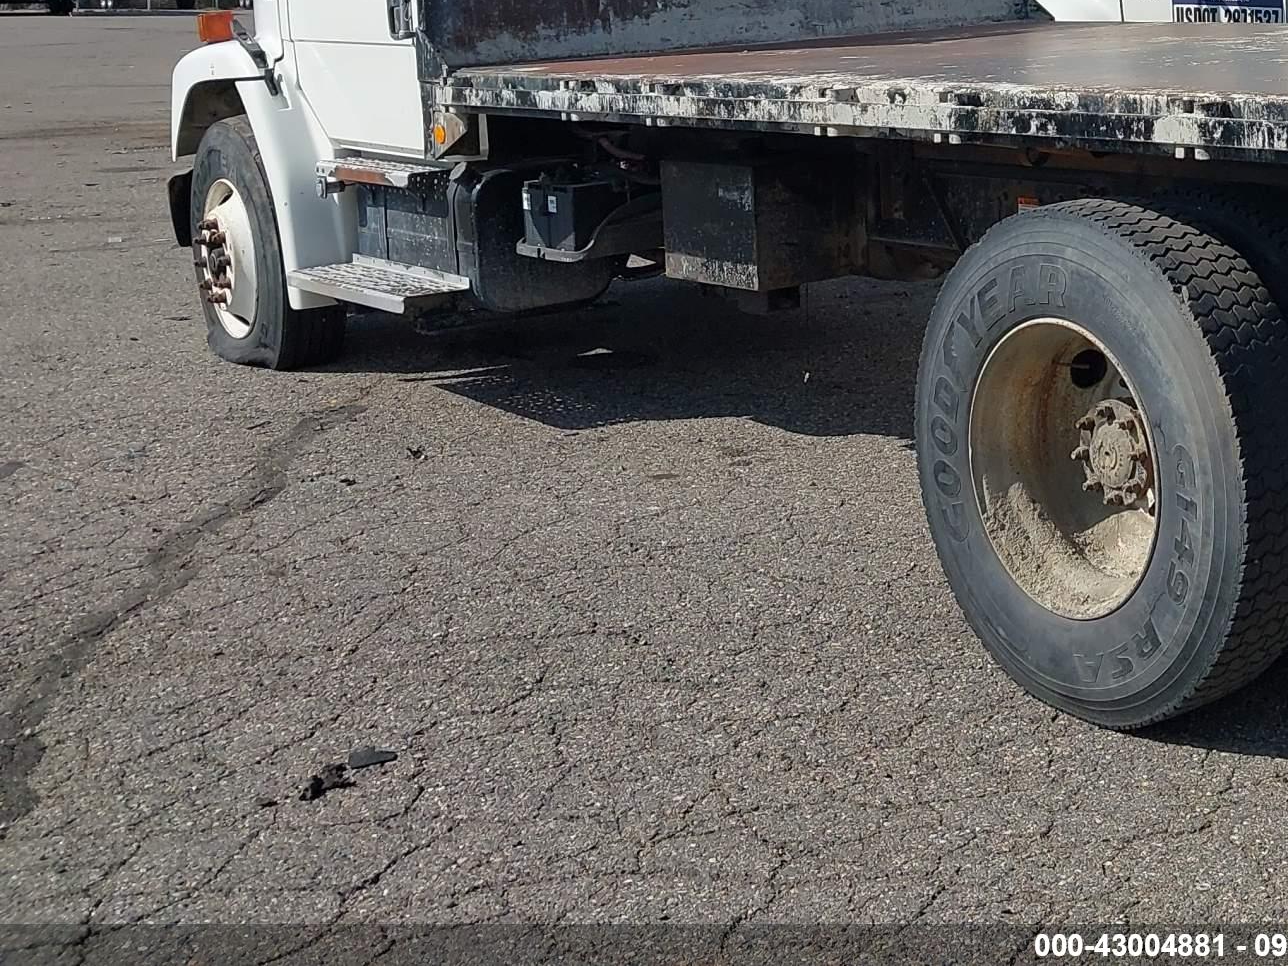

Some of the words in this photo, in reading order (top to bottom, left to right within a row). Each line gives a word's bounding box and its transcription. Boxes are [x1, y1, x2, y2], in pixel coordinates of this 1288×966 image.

[1175, 7, 1218, 22] USDOT
[931, 263, 1068, 543] GOODYEAR
[1166, 443, 1199, 606] G149
[1073, 617, 1162, 683] RSA
